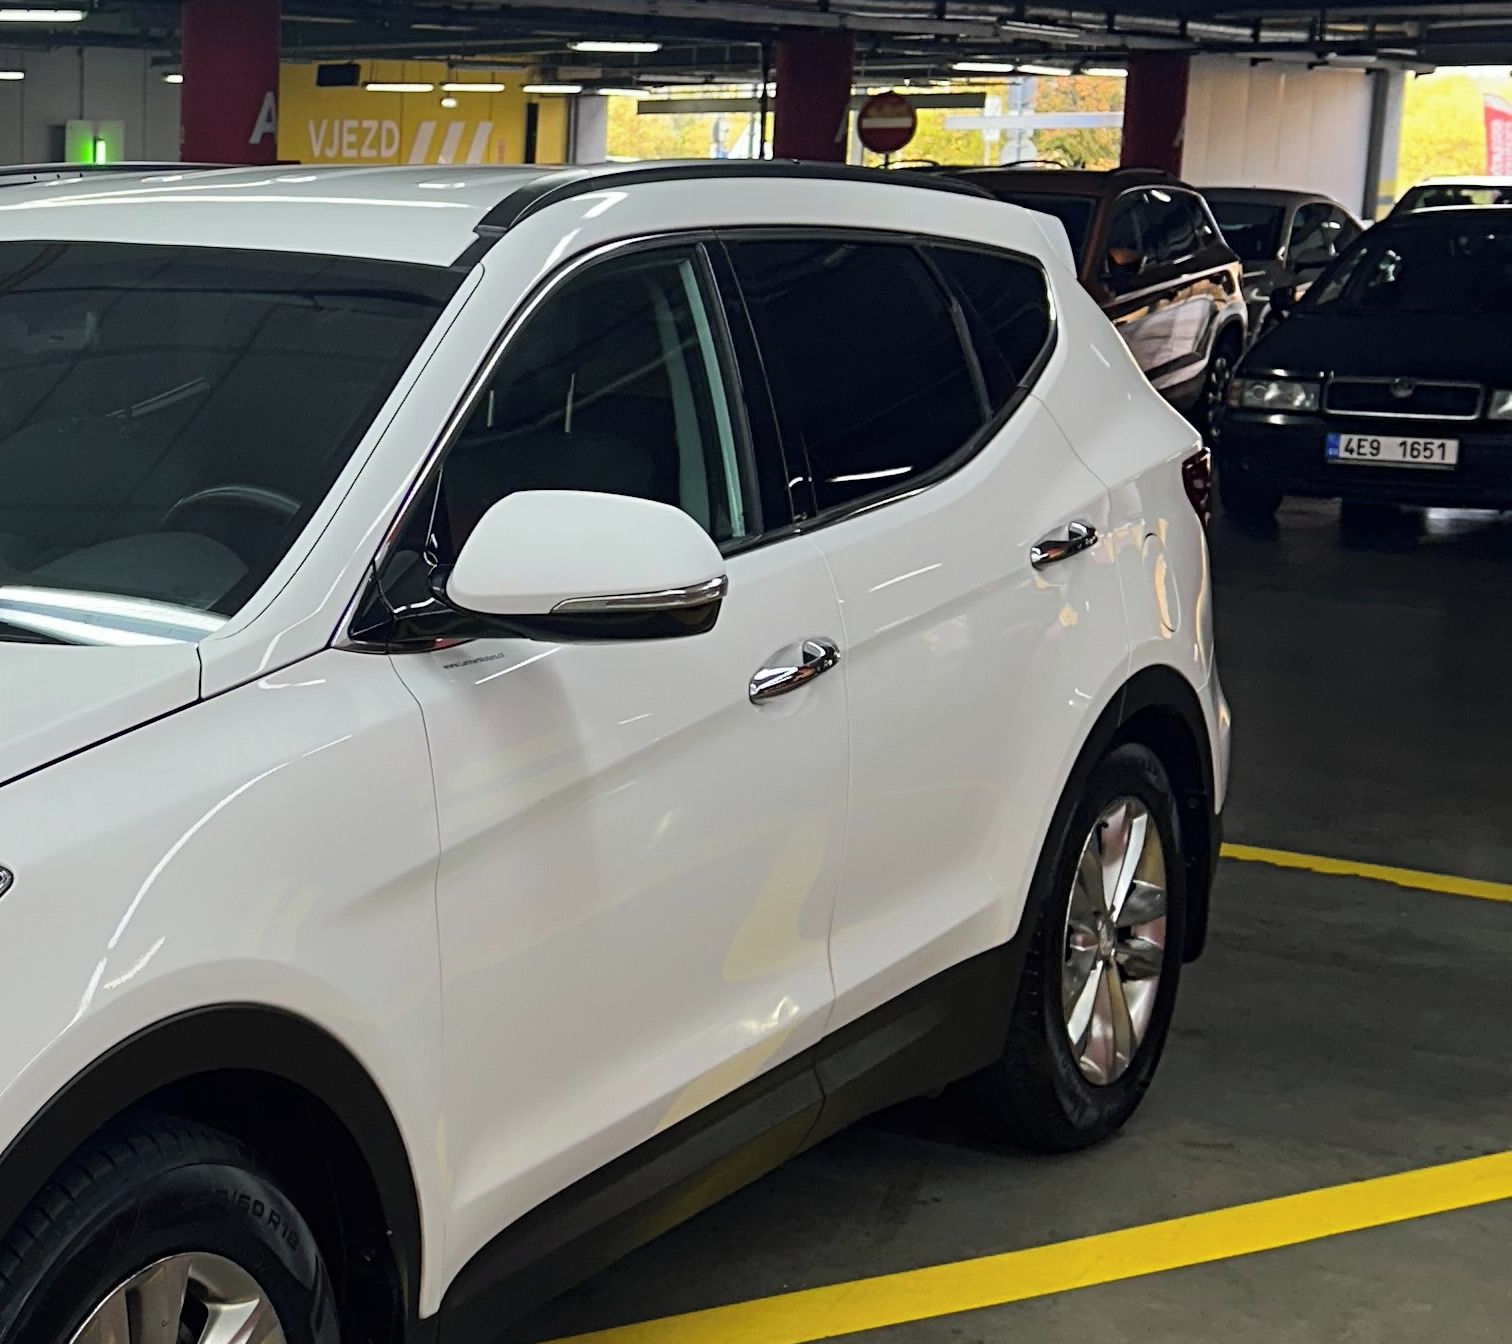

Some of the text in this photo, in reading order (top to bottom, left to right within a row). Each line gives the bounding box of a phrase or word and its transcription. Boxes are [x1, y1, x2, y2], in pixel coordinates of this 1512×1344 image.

[308, 119, 400, 157] VJEZD
[1344, 438, 1381, 456] 4E9
[1399, 440, 1447, 461] 1651
